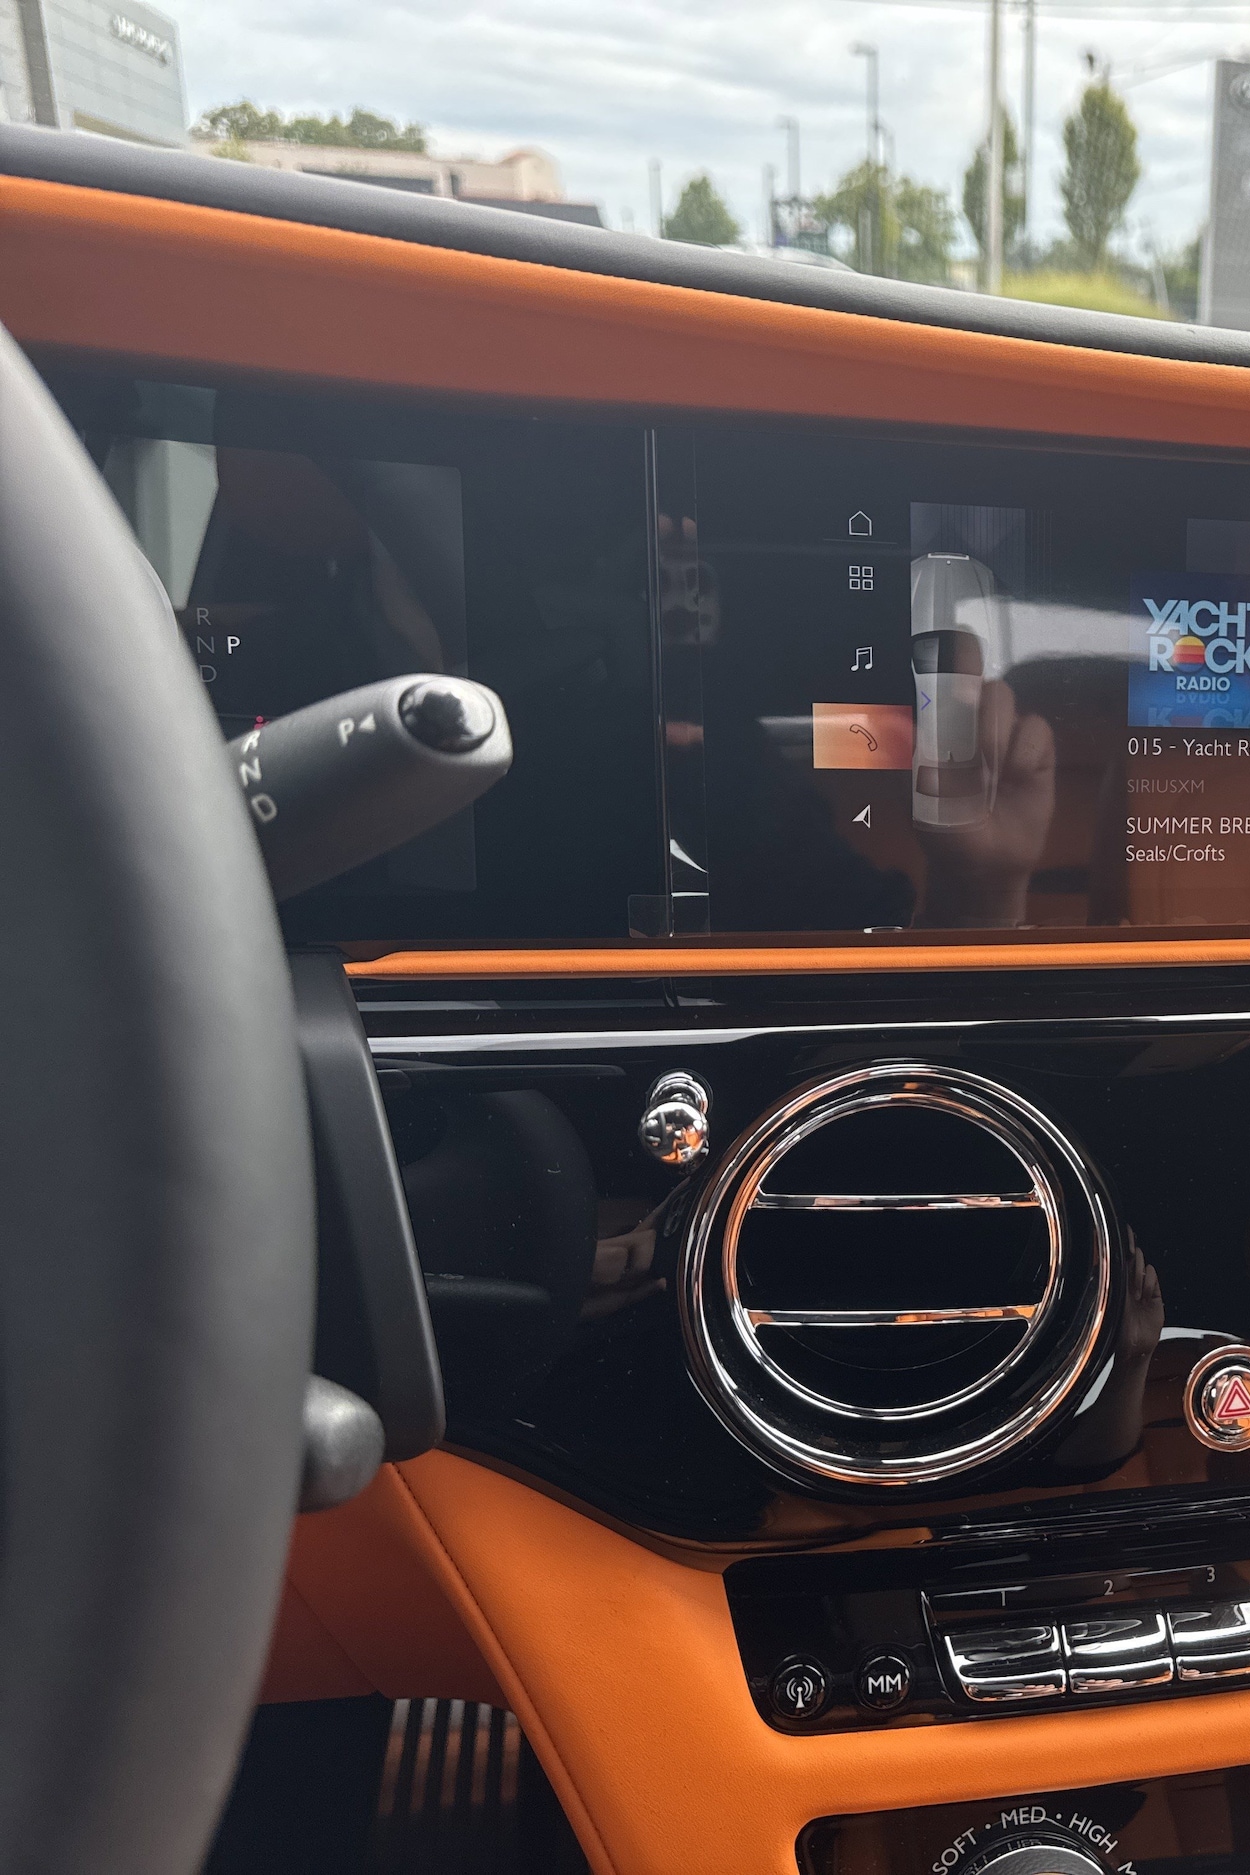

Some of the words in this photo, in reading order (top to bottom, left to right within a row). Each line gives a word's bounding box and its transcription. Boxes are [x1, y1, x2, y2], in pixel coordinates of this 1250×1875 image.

[196, 607, 212, 626] R
[196, 636, 215, 654] N
[227, 636, 241, 654] P
[200, 665, 217, 682] D
[1176, 676, 1231, 691] RADIO
[241, 729, 261, 754] R
[338, 717, 355, 748] P
[1127, 738, 1162, 756] 015
[1183, 738, 1232, 758] Yacht
[240, 757, 262, 786] N
[1127, 779, 1205, 794] SIRIUSXM
[251, 793, 277, 823] D
[1126, 816, 1213, 834] SUMMER
[1126, 844, 1225, 863] Seals/Crofts
[1104, 1580, 1114, 1595] 2
[1207, 1567, 1216, 1582] 3
[868, 1672, 902, 1694] MM
[932, 1827, 977, 1875] SOFT
[1001, 1806, 1047, 1829] MED
[1068, 1813, 1118, 1854] HIGH
